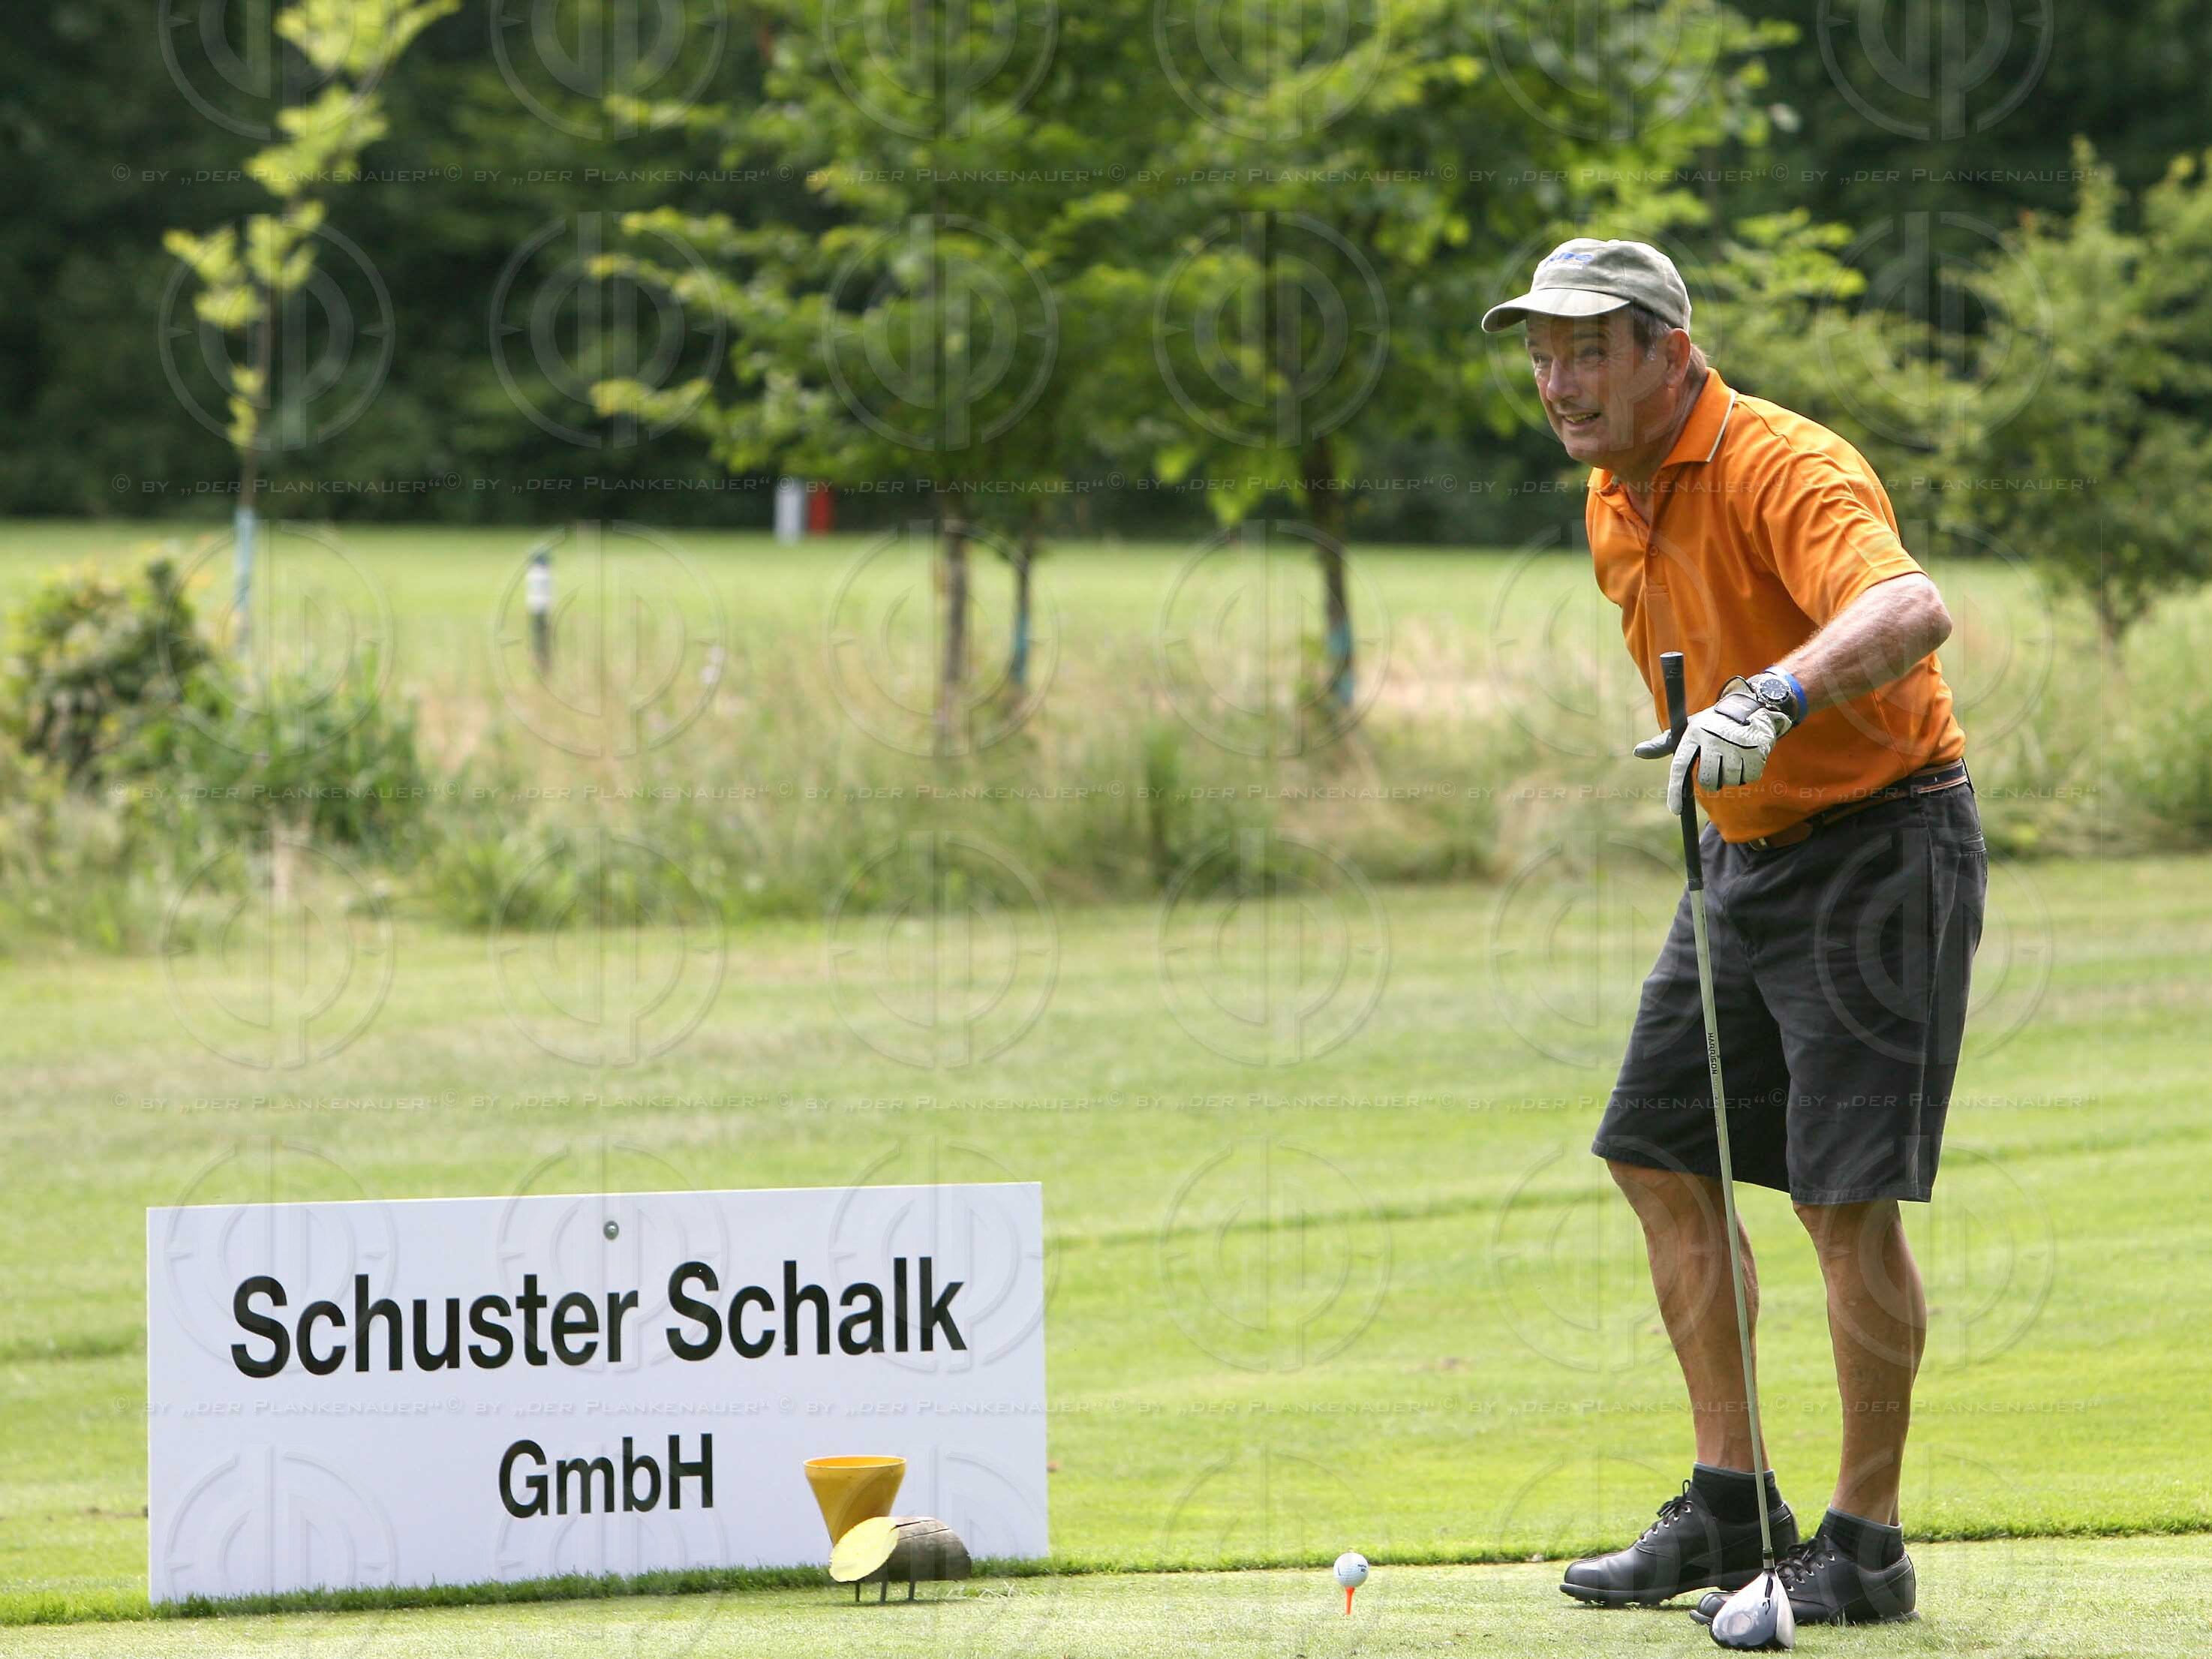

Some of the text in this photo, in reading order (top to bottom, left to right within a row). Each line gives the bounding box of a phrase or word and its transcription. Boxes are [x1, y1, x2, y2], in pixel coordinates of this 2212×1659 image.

[1707, 1032, 1718, 1074] HARRISON
[231, 1257, 966, 1378] Schuster Schalk
[500, 1434, 713, 1518] GmbH
